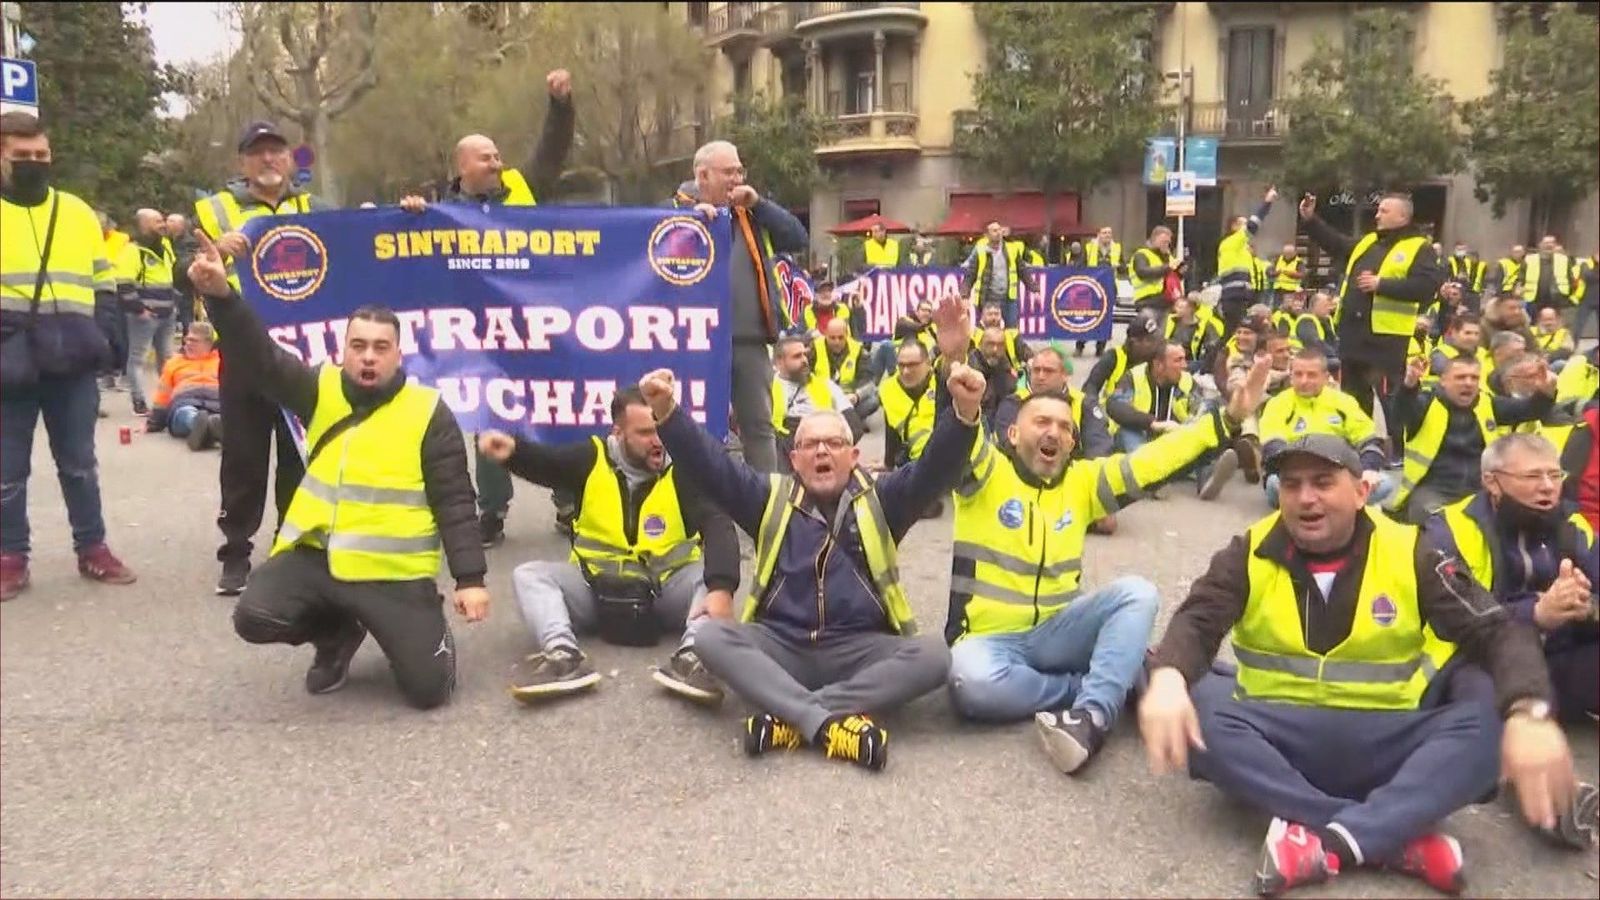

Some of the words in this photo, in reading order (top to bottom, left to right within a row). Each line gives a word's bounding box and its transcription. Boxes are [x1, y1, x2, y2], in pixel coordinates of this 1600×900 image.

[3, 62, 29, 97] P
[374, 229, 600, 259] SINTRAPORT
[447, 258, 492, 270] SINCE
